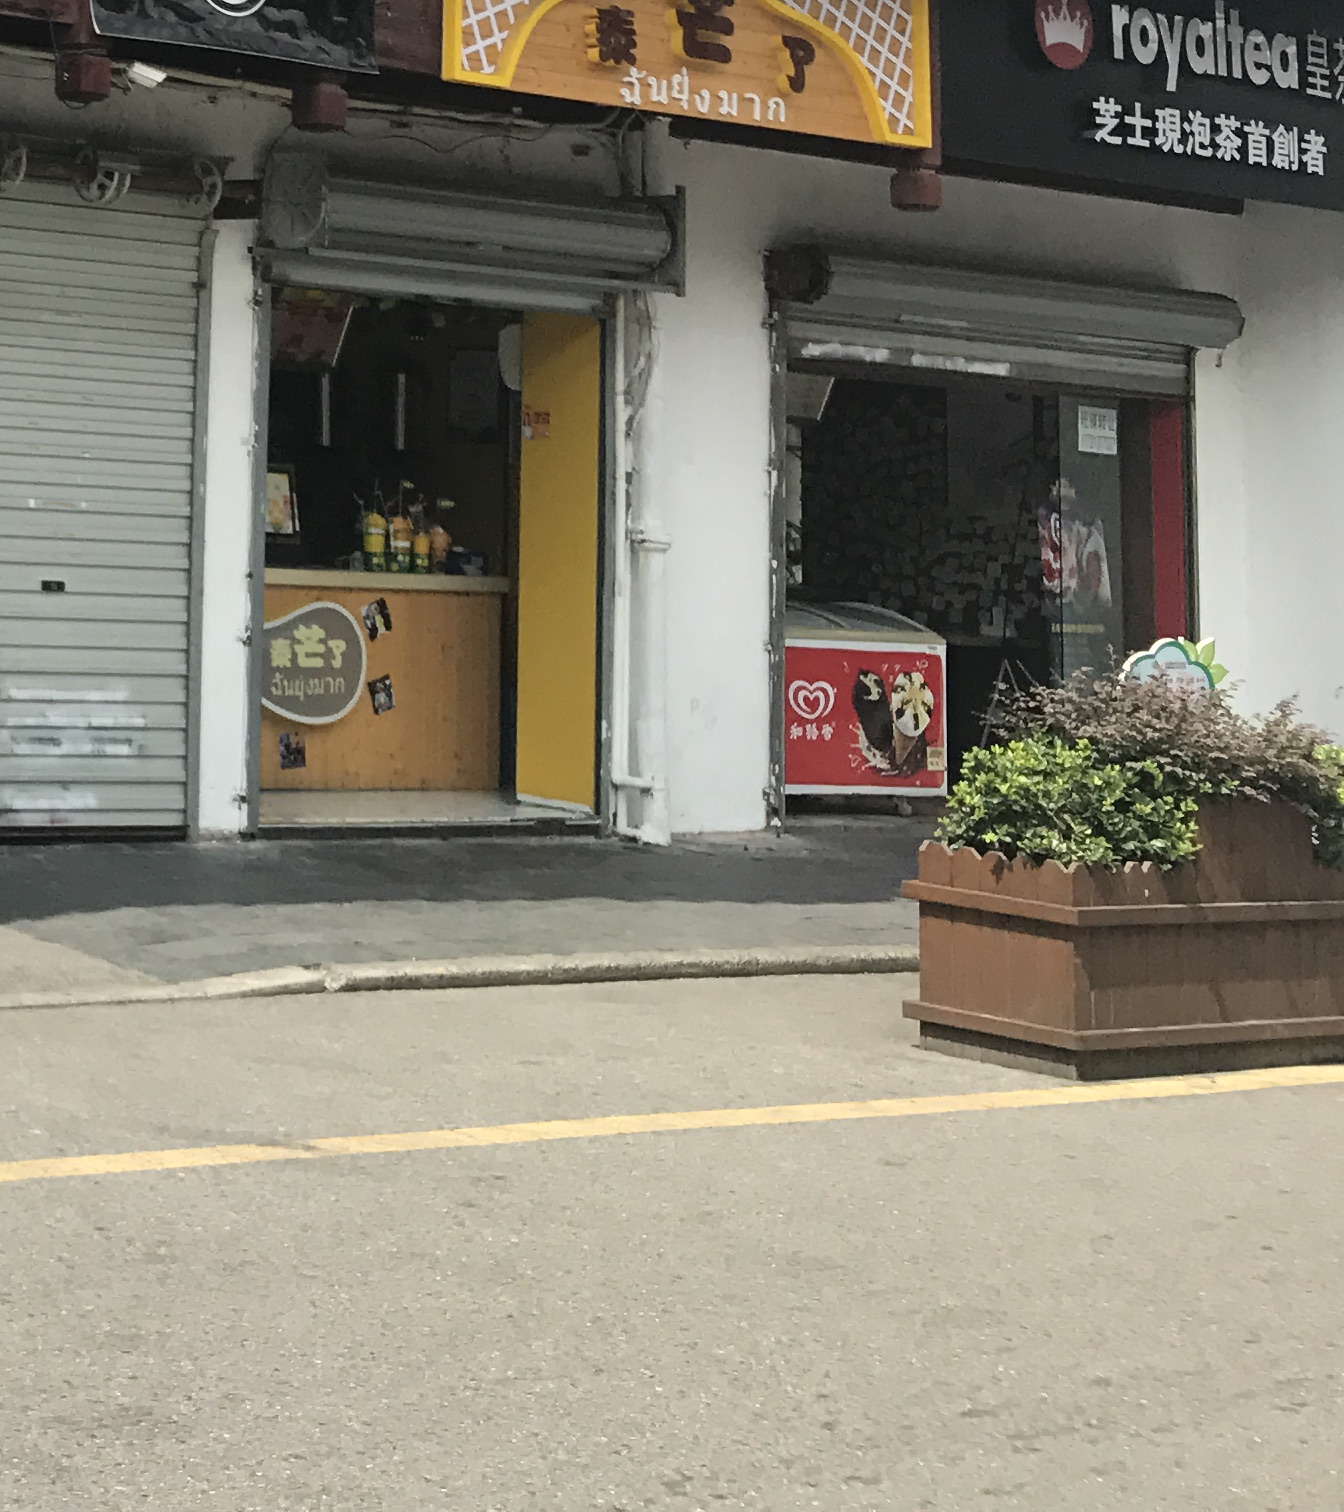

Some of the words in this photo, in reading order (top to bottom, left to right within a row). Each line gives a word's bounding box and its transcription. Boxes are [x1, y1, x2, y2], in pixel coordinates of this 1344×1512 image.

[1111, 0, 1299, 91] royaltea
[1092, 95, 1328, 176] 芝士現泡茶首創者
